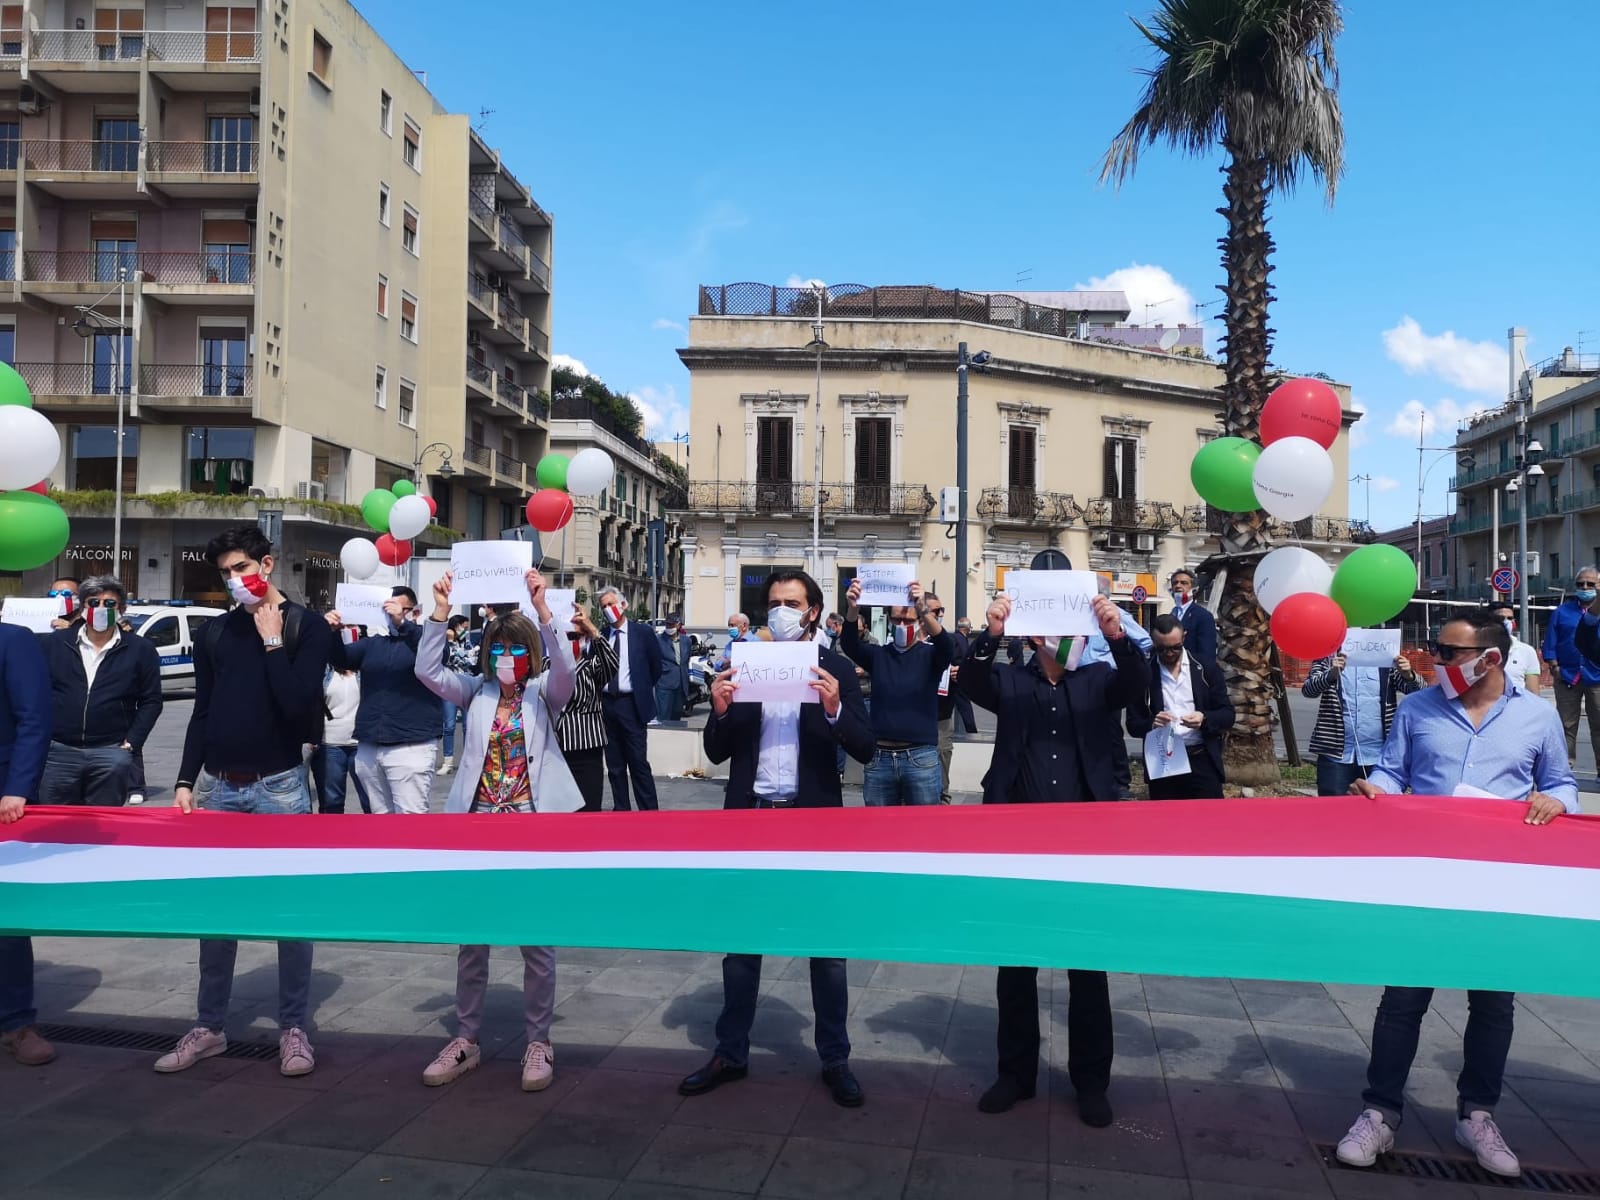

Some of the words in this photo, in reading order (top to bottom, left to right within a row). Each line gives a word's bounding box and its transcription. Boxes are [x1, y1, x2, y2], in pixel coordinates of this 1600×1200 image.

[66, 549, 132, 561] FALCONRI
[1007, 587, 1055, 612] PARTITE
[1063, 593, 1092, 612] IVA
[738, 661, 804, 684] ARTISTI
